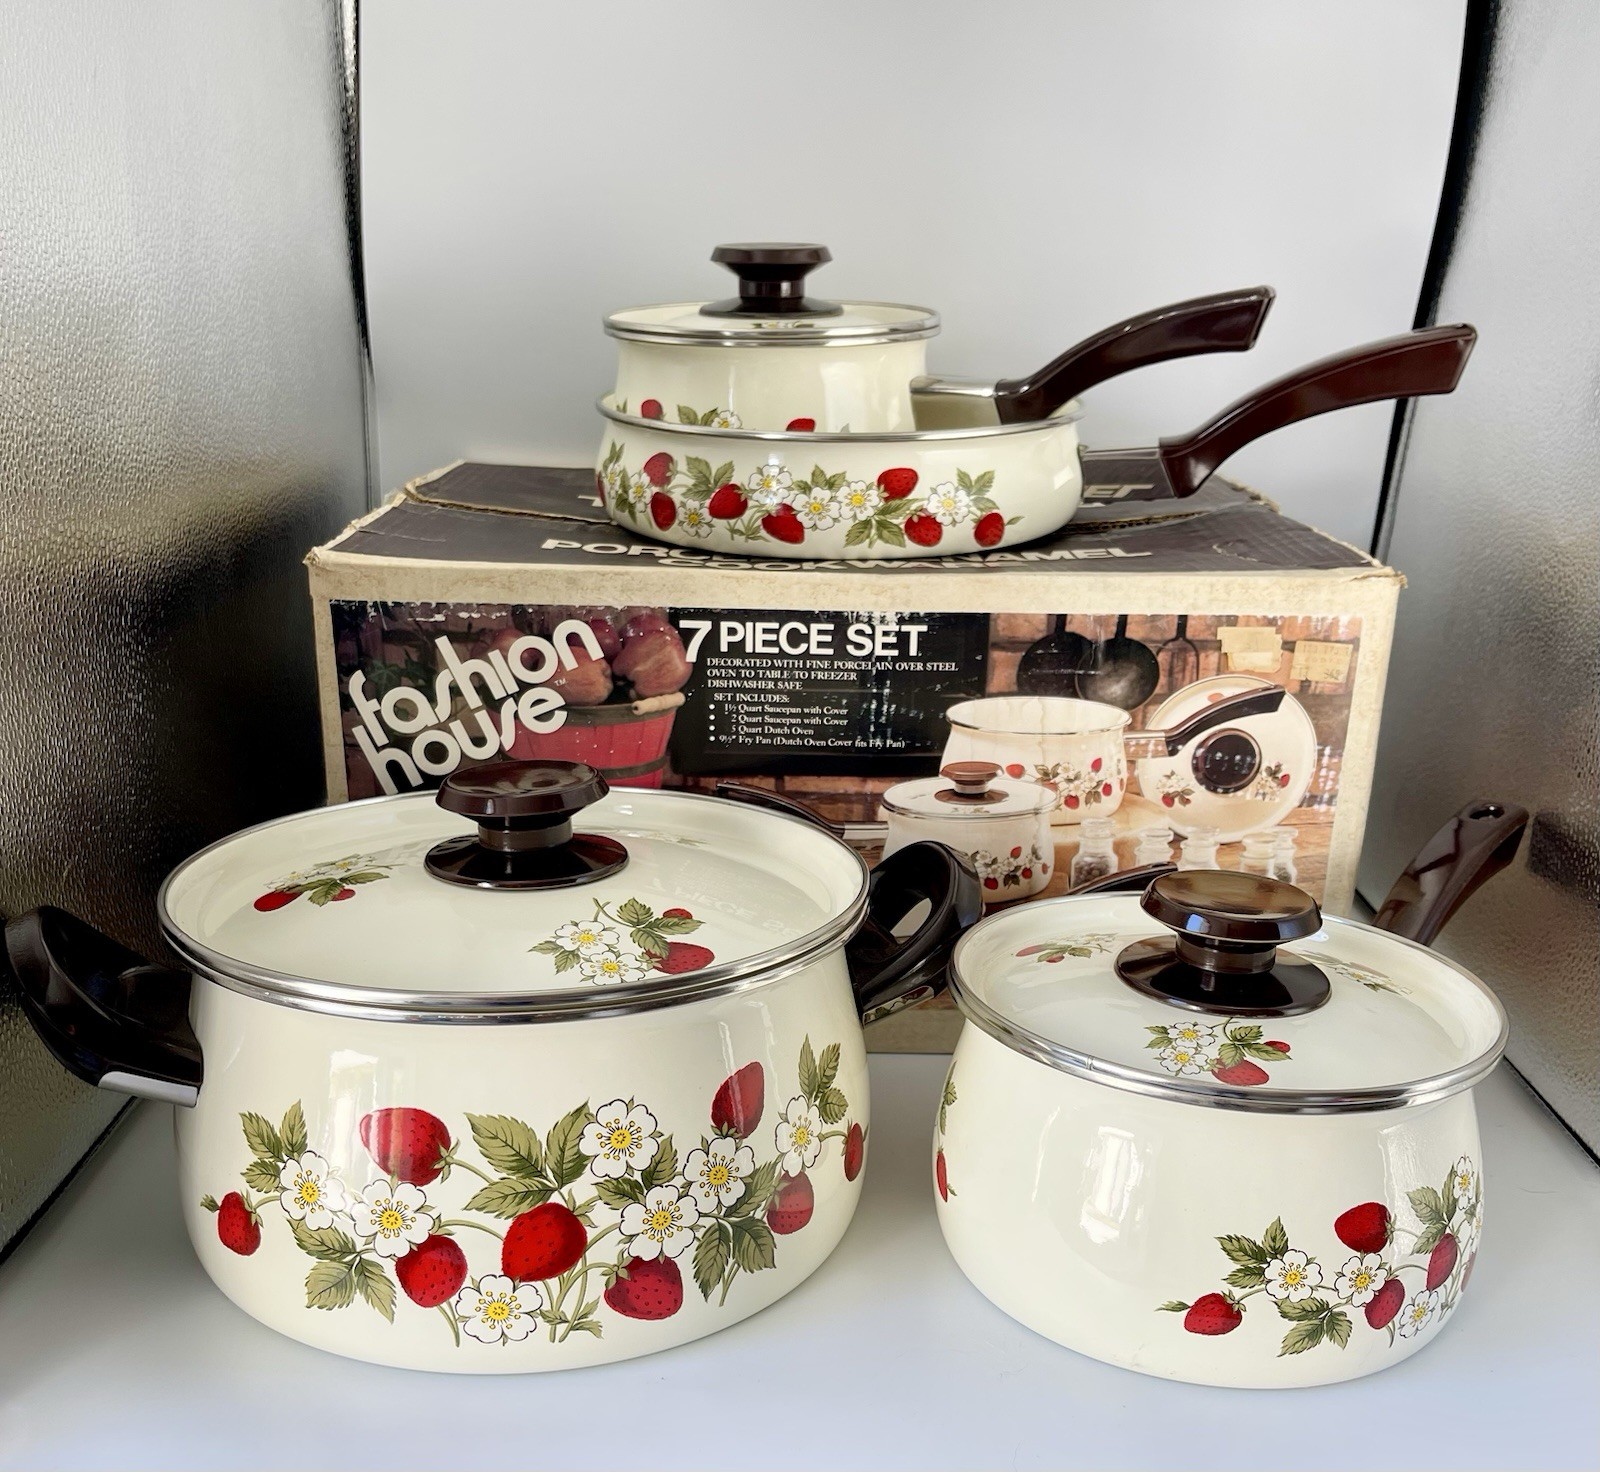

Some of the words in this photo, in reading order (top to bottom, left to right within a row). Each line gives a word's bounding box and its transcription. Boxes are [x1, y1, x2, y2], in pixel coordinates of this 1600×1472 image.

[1081, 484, 1155, 498] ET
[678, 620, 713, 663] 7
[719, 621, 835, 656] PIECE
[846, 622, 929, 658] SET
[706, 657, 772, 668] DECORATED
[773, 658, 804, 669] WITH
[806, 660, 832, 669] FINE
[833, 660, 893, 671] PORCELAIN
[895, 661, 924, 671] OVER
[926, 661, 960, 671] STEEL
[706, 668, 737, 678] OVEN
[739, 669, 755, 678] TO
[756, 669, 791, 679] TABLE
[793, 670, 809, 680] TO
[811, 671, 858, 681] FREEZER
[348, 619, 605, 747] fashion
[707, 679, 776, 690] DISHWASHER
[777, 680, 804, 690] SAFE
[713, 692, 734, 702] SET
[736, 693, 790, 703] INCLUDES:
[738, 703, 762, 714] Quart
[764, 704, 801, 715] Saucepan
[803, 705, 822, 715] with
[823, 706, 849, 715] Cover
[731, 714, 737, 723] 2
[738, 714, 762, 724] Quart
[764, 714, 801, 725] Saucepan
[803, 715, 822, 725] with
[823, 716, 849, 726] Cover
[731, 725, 737, 733] 5
[738, 725, 762, 734] Quart
[764, 725, 790, 735] Dutch
[792, 726, 815, 735] Oven
[352, 687, 568, 796] house
[738, 735, 754, 746] Fry
[755, 736, 772, 745] Pan
[773, 736, 803, 746] (Dutch
[804, 738, 827, 747] Oven
[827, 738, 853, 747] Cover
[854, 738, 867, 748] fits
[869, 739, 885, 750] Fry
[886, 739, 906, 749] Pan)
